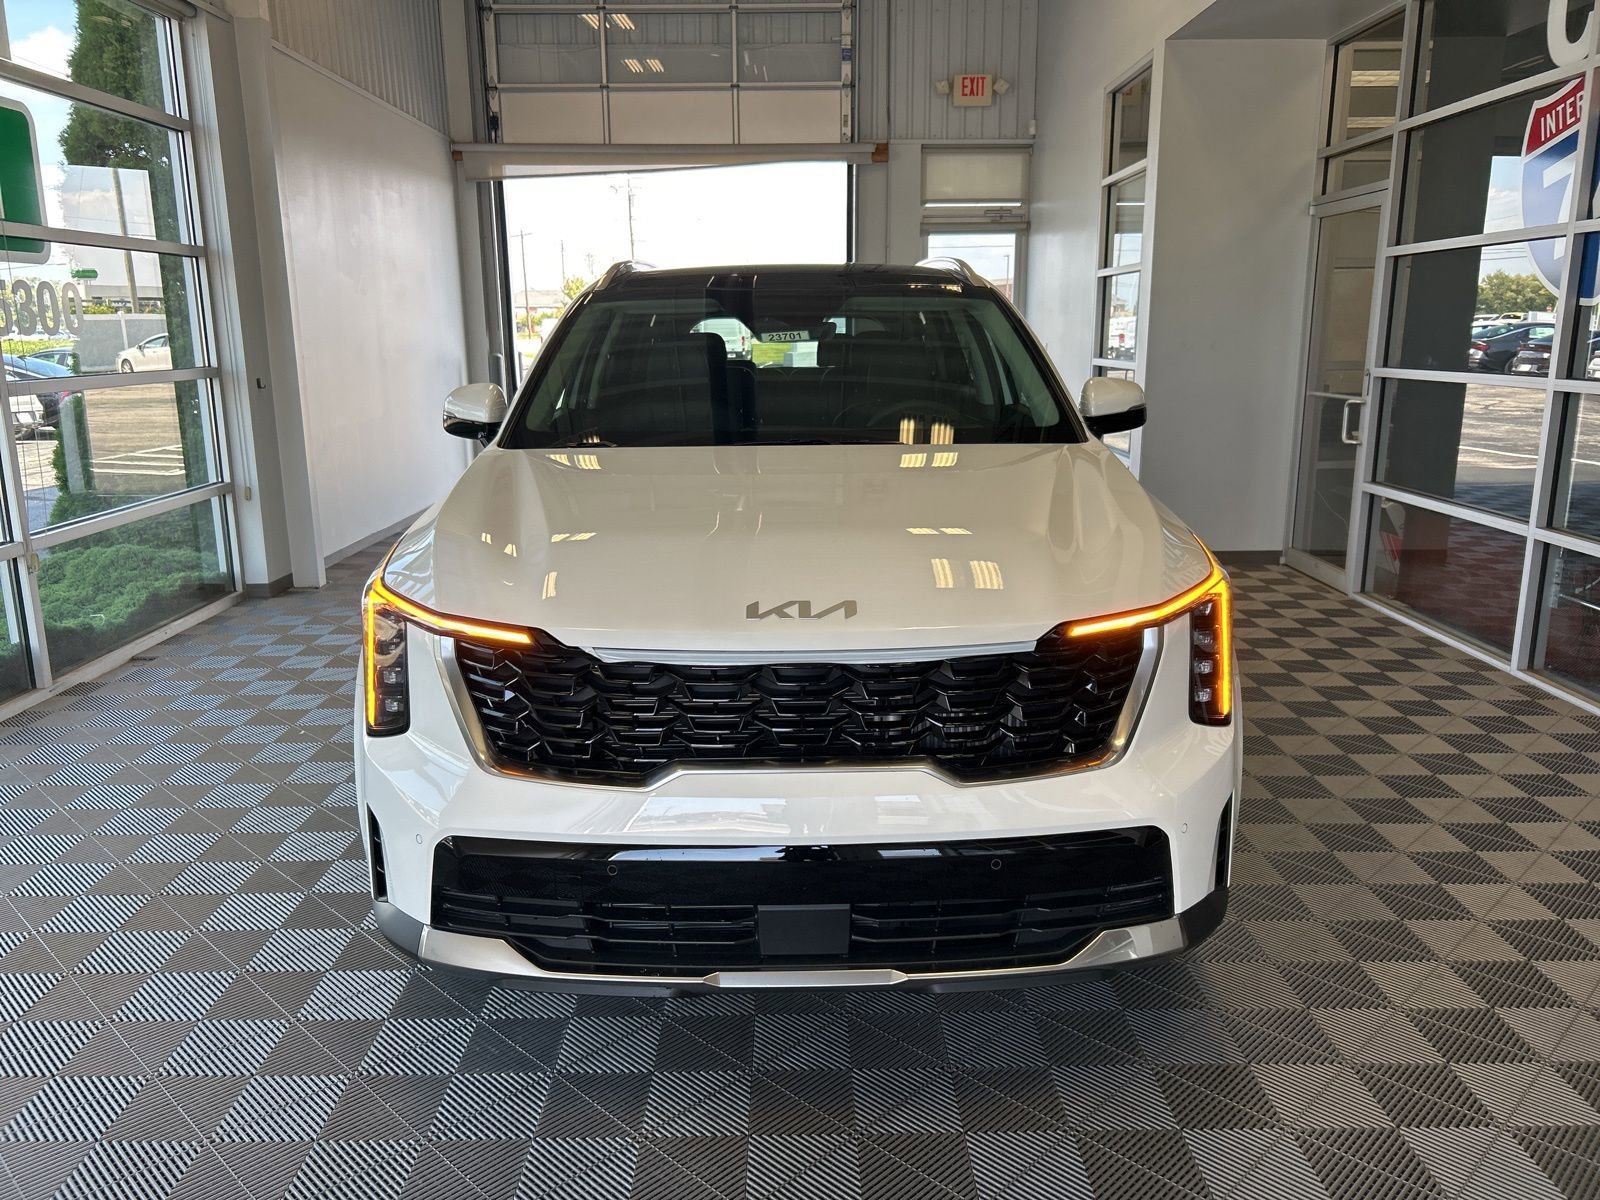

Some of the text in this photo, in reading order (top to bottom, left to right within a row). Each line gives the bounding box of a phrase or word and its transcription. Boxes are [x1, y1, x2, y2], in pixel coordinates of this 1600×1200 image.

[961, 76, 986, 97] EXIT
[1541, 90, 1584, 142] INTER
[768, 332, 803, 342] 23701
[746, 600, 857, 620] KIA
